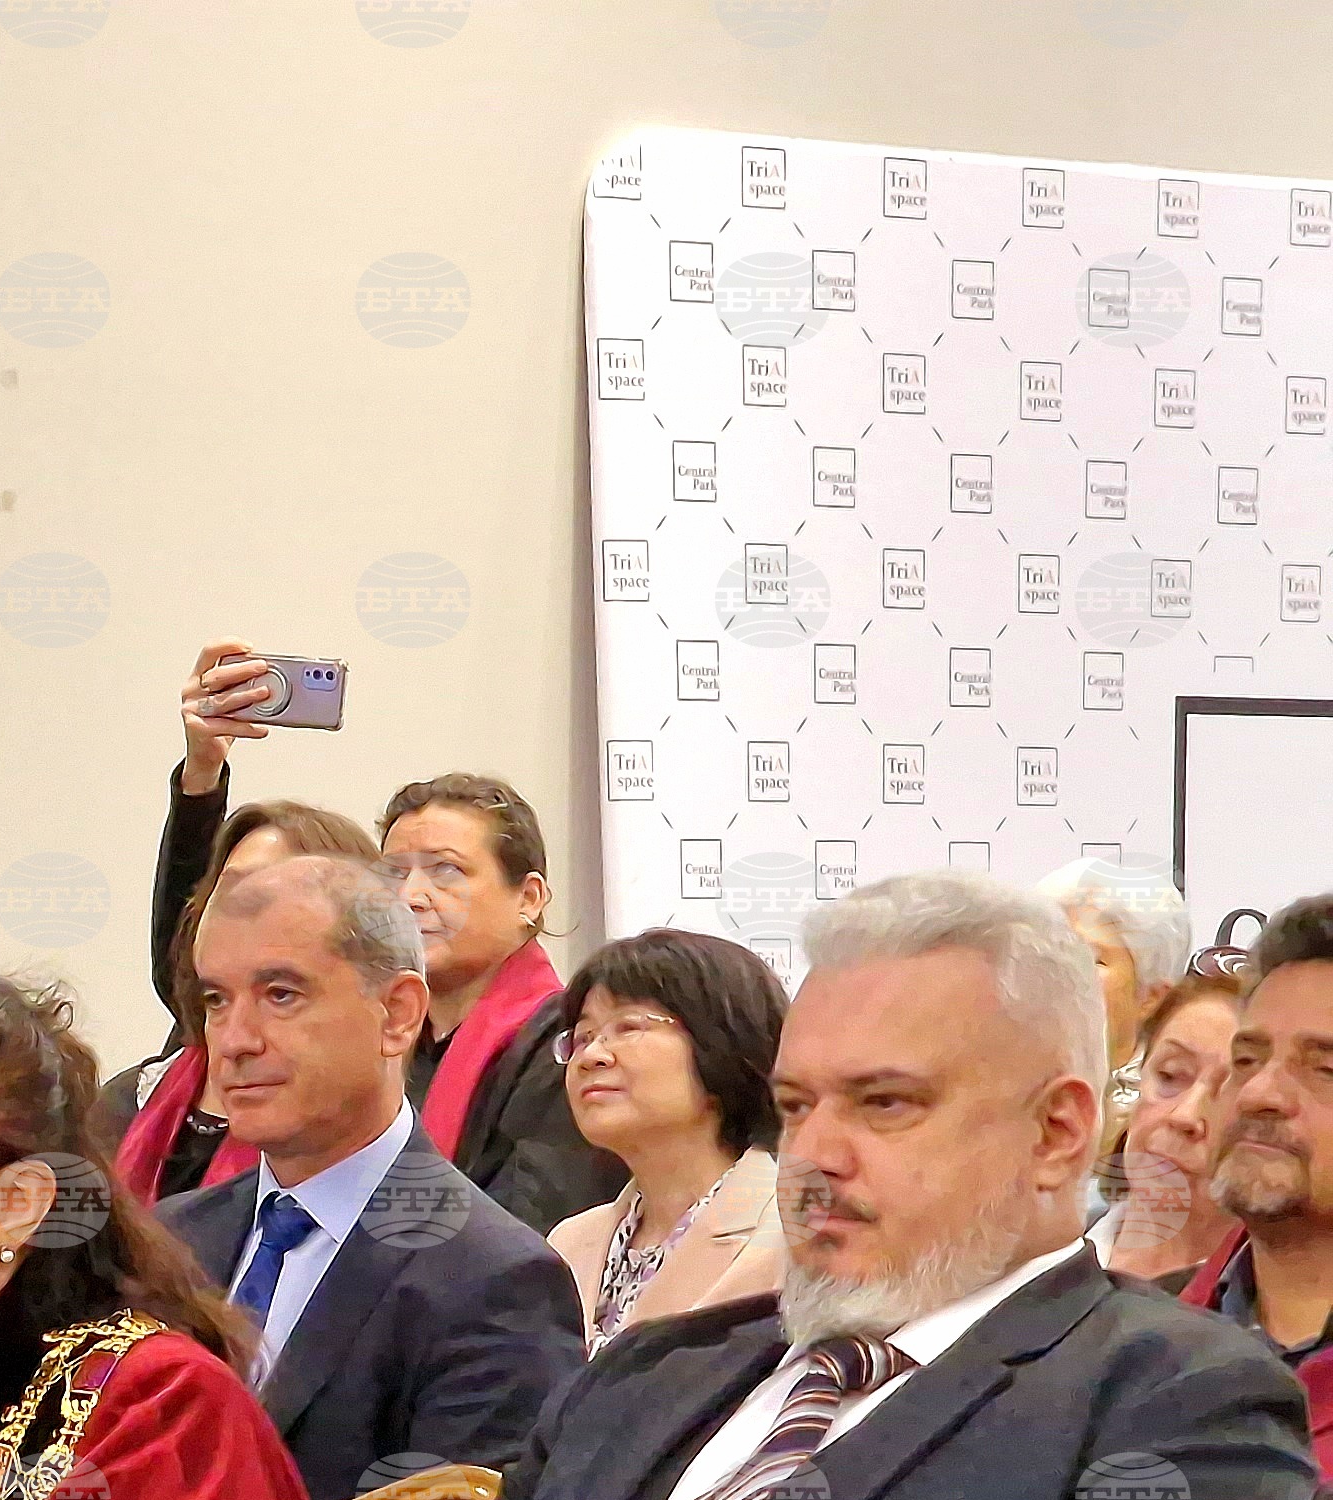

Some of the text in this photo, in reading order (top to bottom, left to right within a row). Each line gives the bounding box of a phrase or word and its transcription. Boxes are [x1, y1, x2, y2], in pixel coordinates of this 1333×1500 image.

[749, 180, 785, 198] space
[890, 194, 926, 208] space
[1029, 203, 1064, 218] space
[1164, 213, 1198, 226] space
[1296, 223, 1331, 237] space
[608, 375, 644, 390] space
[750, 381, 786, 396] space
[890, 389, 925, 405] space
[1027, 397, 1061, 411] space
[1161, 404, 1194, 417] space
[1292, 411, 1325, 425] space
[693, 479, 717, 490] Park
[613, 577, 649, 591] space
[753, 580, 788, 595] space
[889, 584, 925, 600] space
[1024, 589, 1059, 604] space
[1157, 594, 1191, 608] space
[1287, 598, 1320, 612] space
[683, 665, 719, 676] Central
[696, 678, 719, 690] Park
[617, 776, 654, 791] space
[754, 776, 789, 792] space
[890, 779, 924, 794] space
[1023, 781, 1057, 797] space
[685, 863, 722, 875] Central
[699, 876, 722, 888] Park
[834, 877, 856, 888] Park
